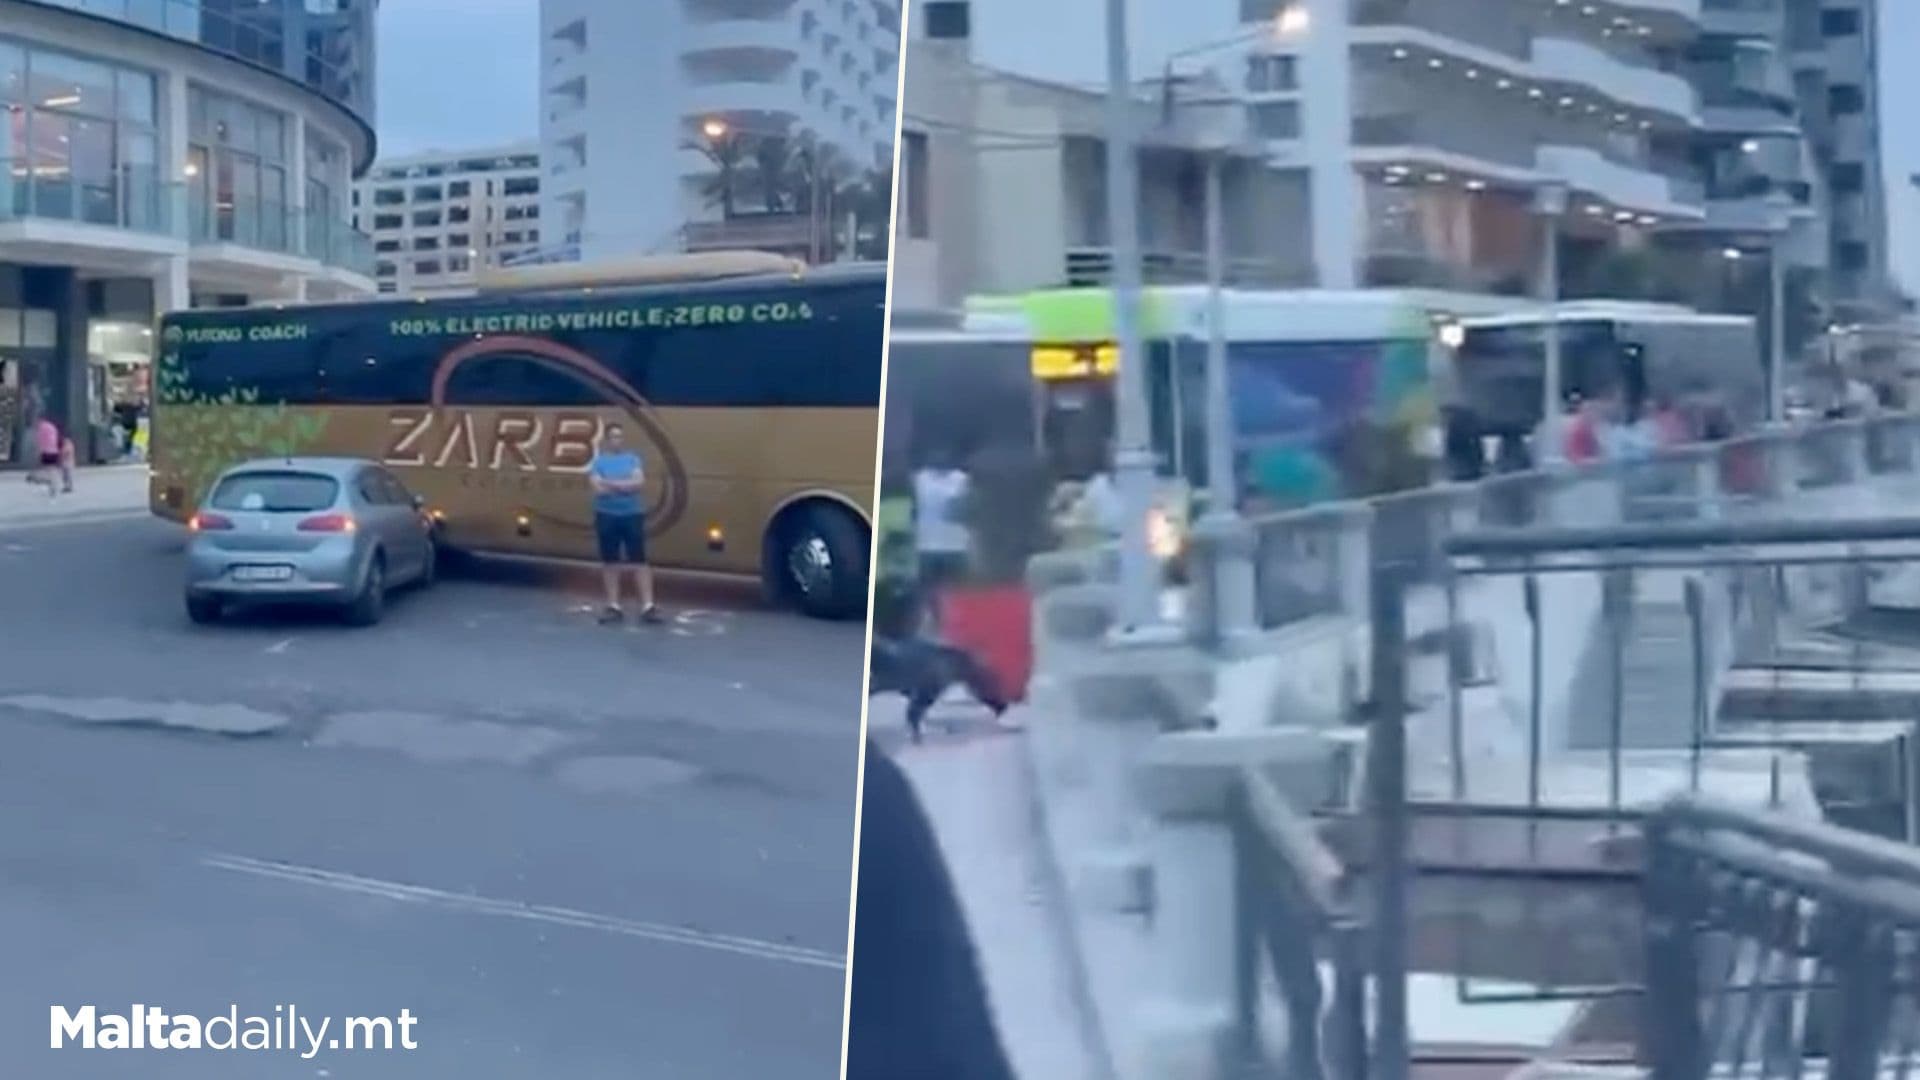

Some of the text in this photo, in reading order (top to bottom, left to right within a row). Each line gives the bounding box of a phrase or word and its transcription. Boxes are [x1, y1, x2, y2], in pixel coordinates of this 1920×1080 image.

[249, 324, 307, 341] COACH
[390, 318, 441, 335] 100%
[446, 313, 550, 333] ELECTRIC
[384, 408, 605, 473] ZARB
